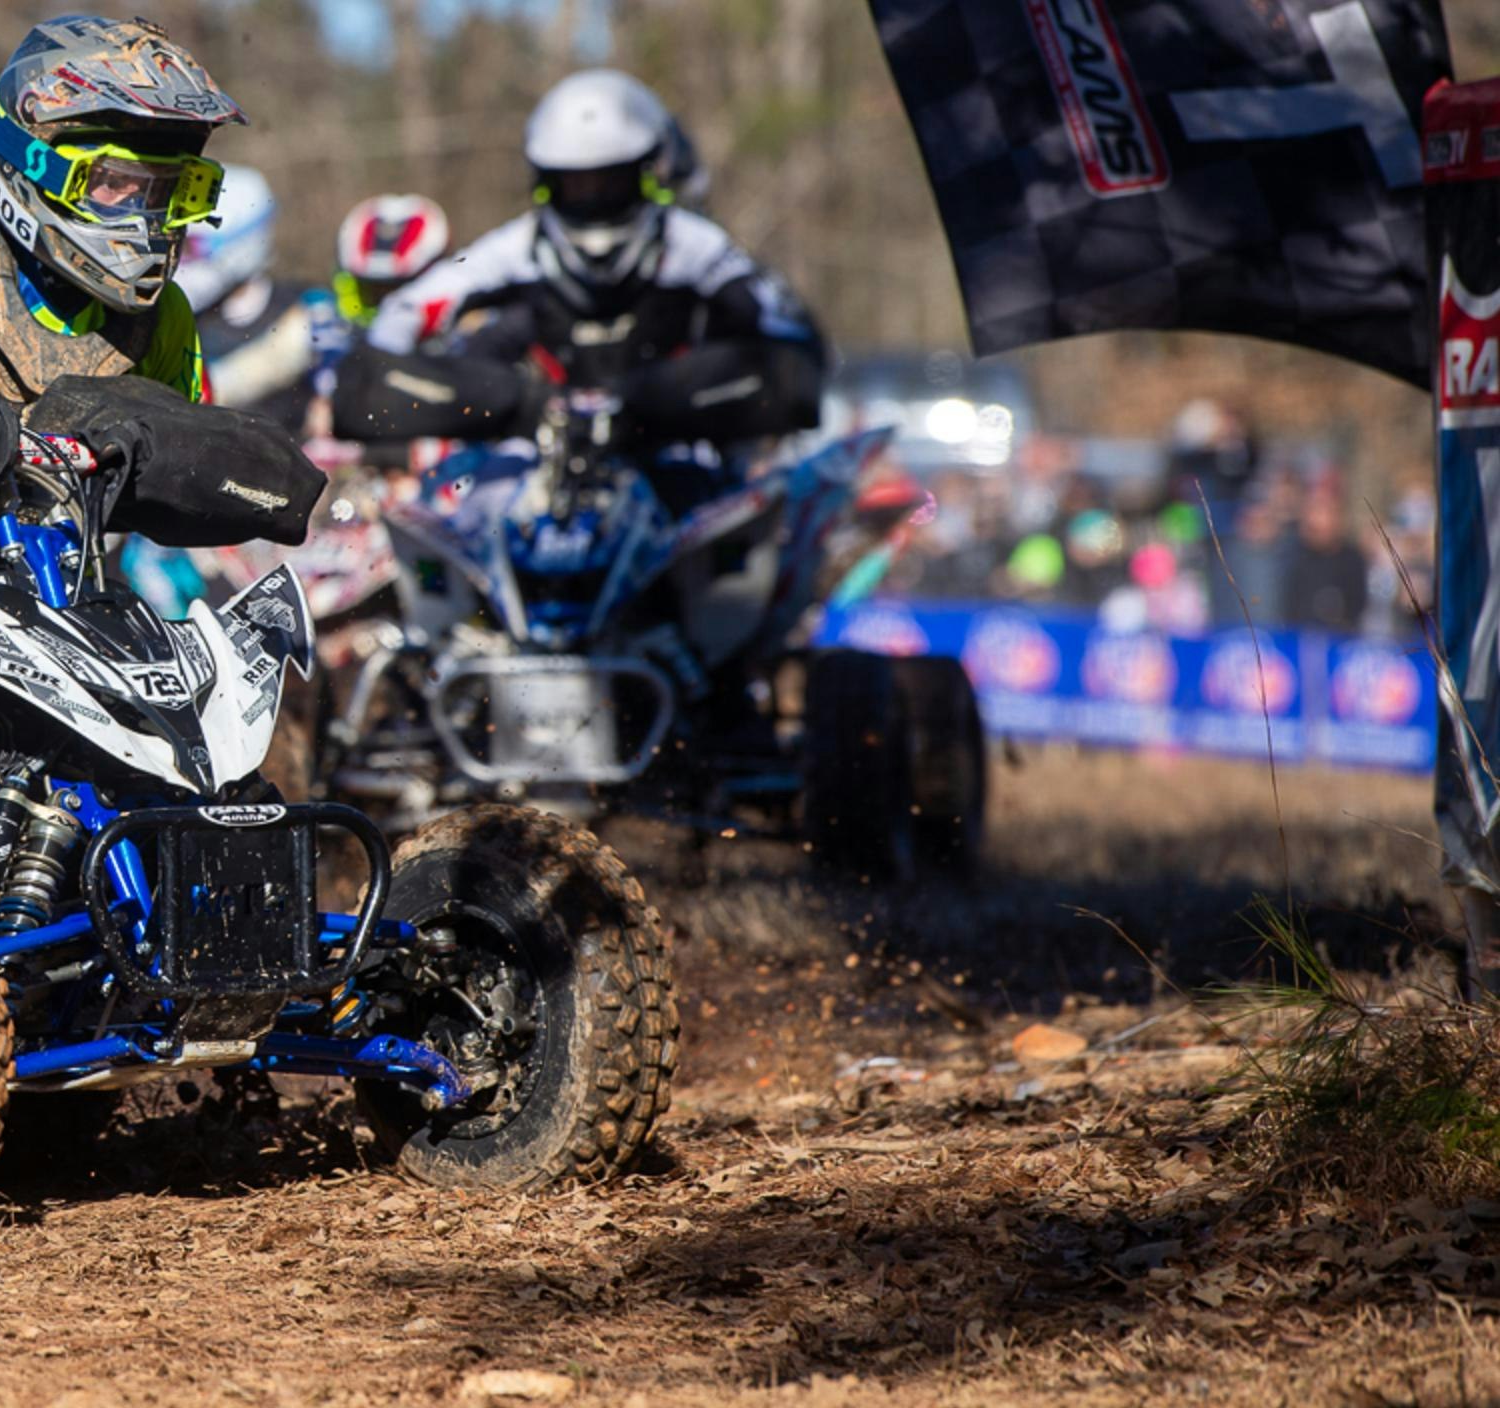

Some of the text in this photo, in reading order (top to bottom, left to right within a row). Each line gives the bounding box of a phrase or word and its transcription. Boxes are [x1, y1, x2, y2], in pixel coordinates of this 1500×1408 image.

[7, 663, 61, 687] RJR
[132, 670, 187, 696] 723
[242, 657, 273, 684] RJR
